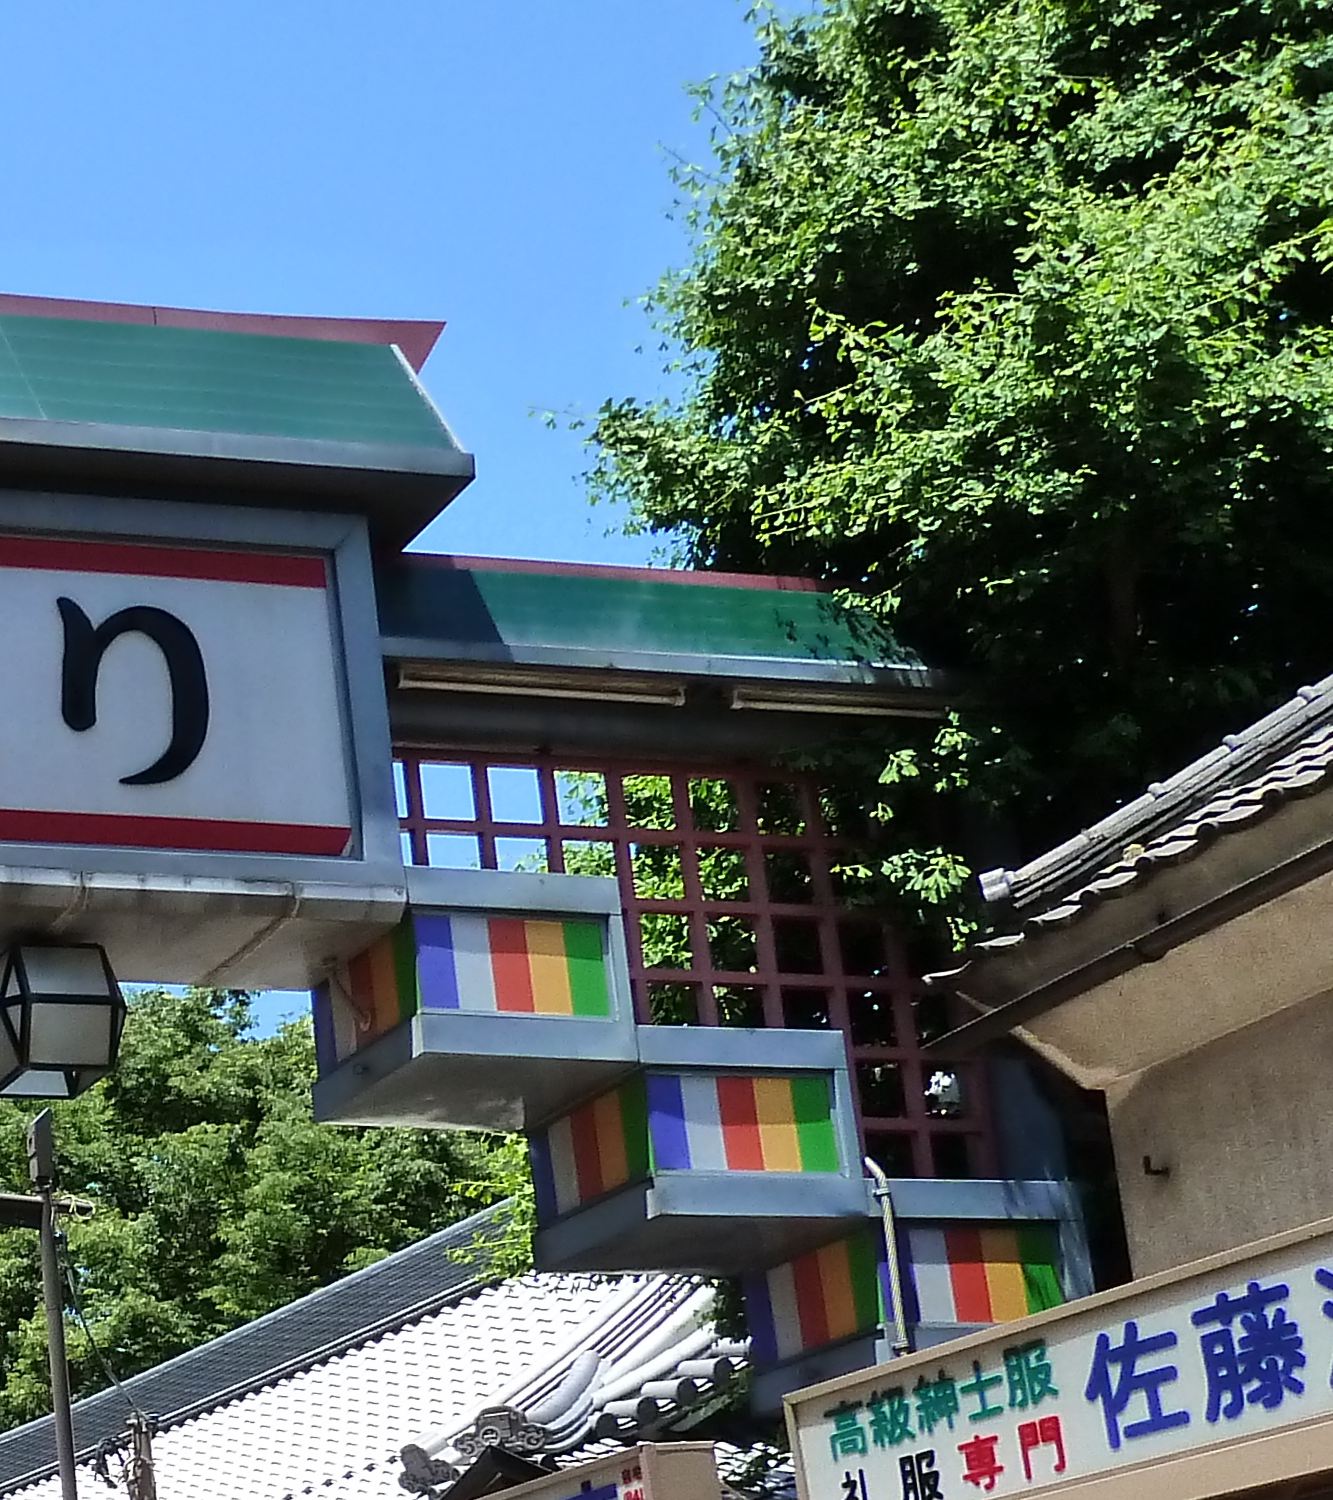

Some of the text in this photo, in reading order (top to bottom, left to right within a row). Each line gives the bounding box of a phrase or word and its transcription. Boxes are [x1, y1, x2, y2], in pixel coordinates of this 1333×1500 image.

[824, 1339, 1059, 1462] 高級紳士服
